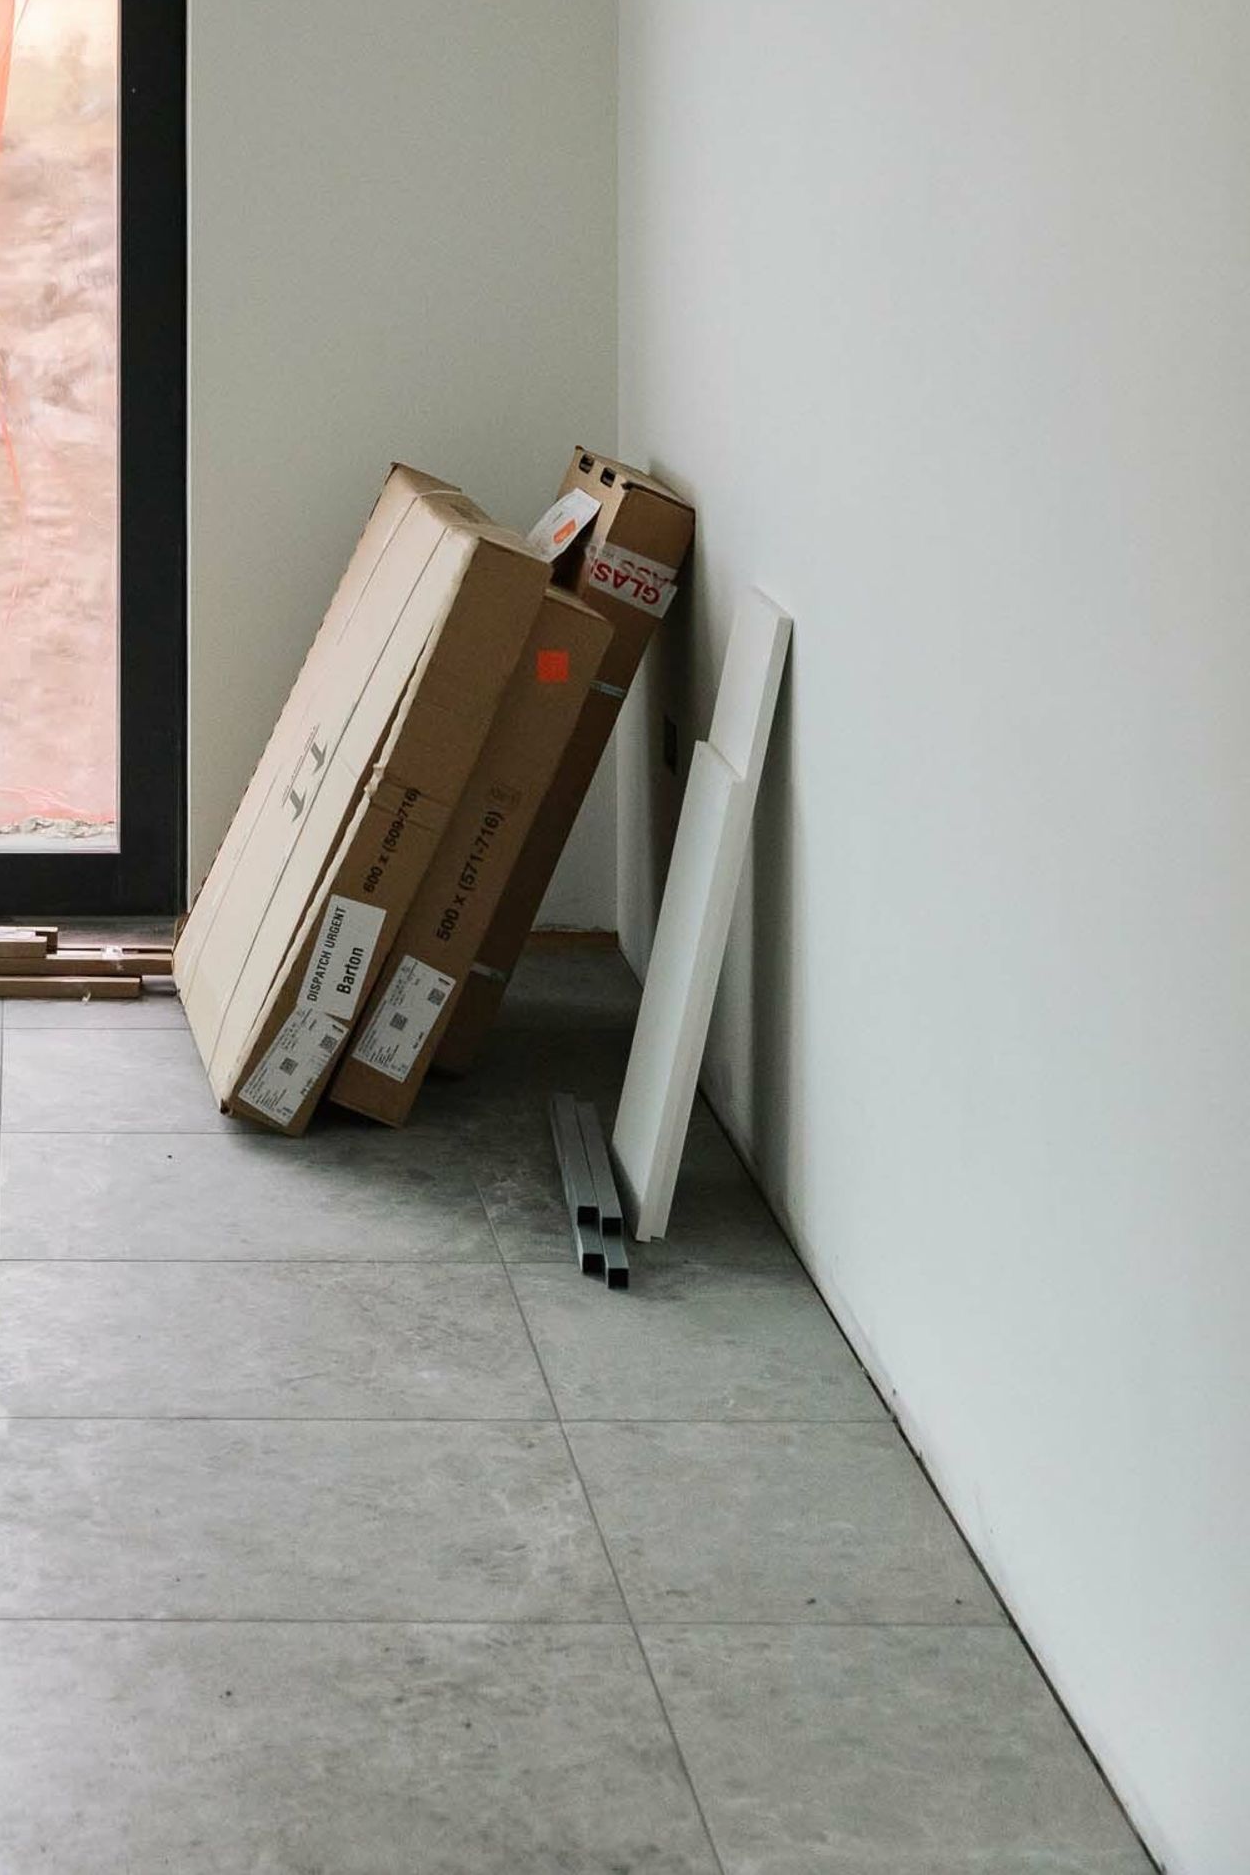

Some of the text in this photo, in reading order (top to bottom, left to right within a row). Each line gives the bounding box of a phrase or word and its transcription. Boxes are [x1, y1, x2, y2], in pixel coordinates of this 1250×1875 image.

[591, 558, 661, 604] GLAS
[363, 866, 384, 894] 600
[379, 855, 390, 866] x
[436, 811, 506, 941] 500 x (571-716)
[307, 906, 347, 1003] DISPATCH URGENT
[336, 947, 365, 995] Barton
